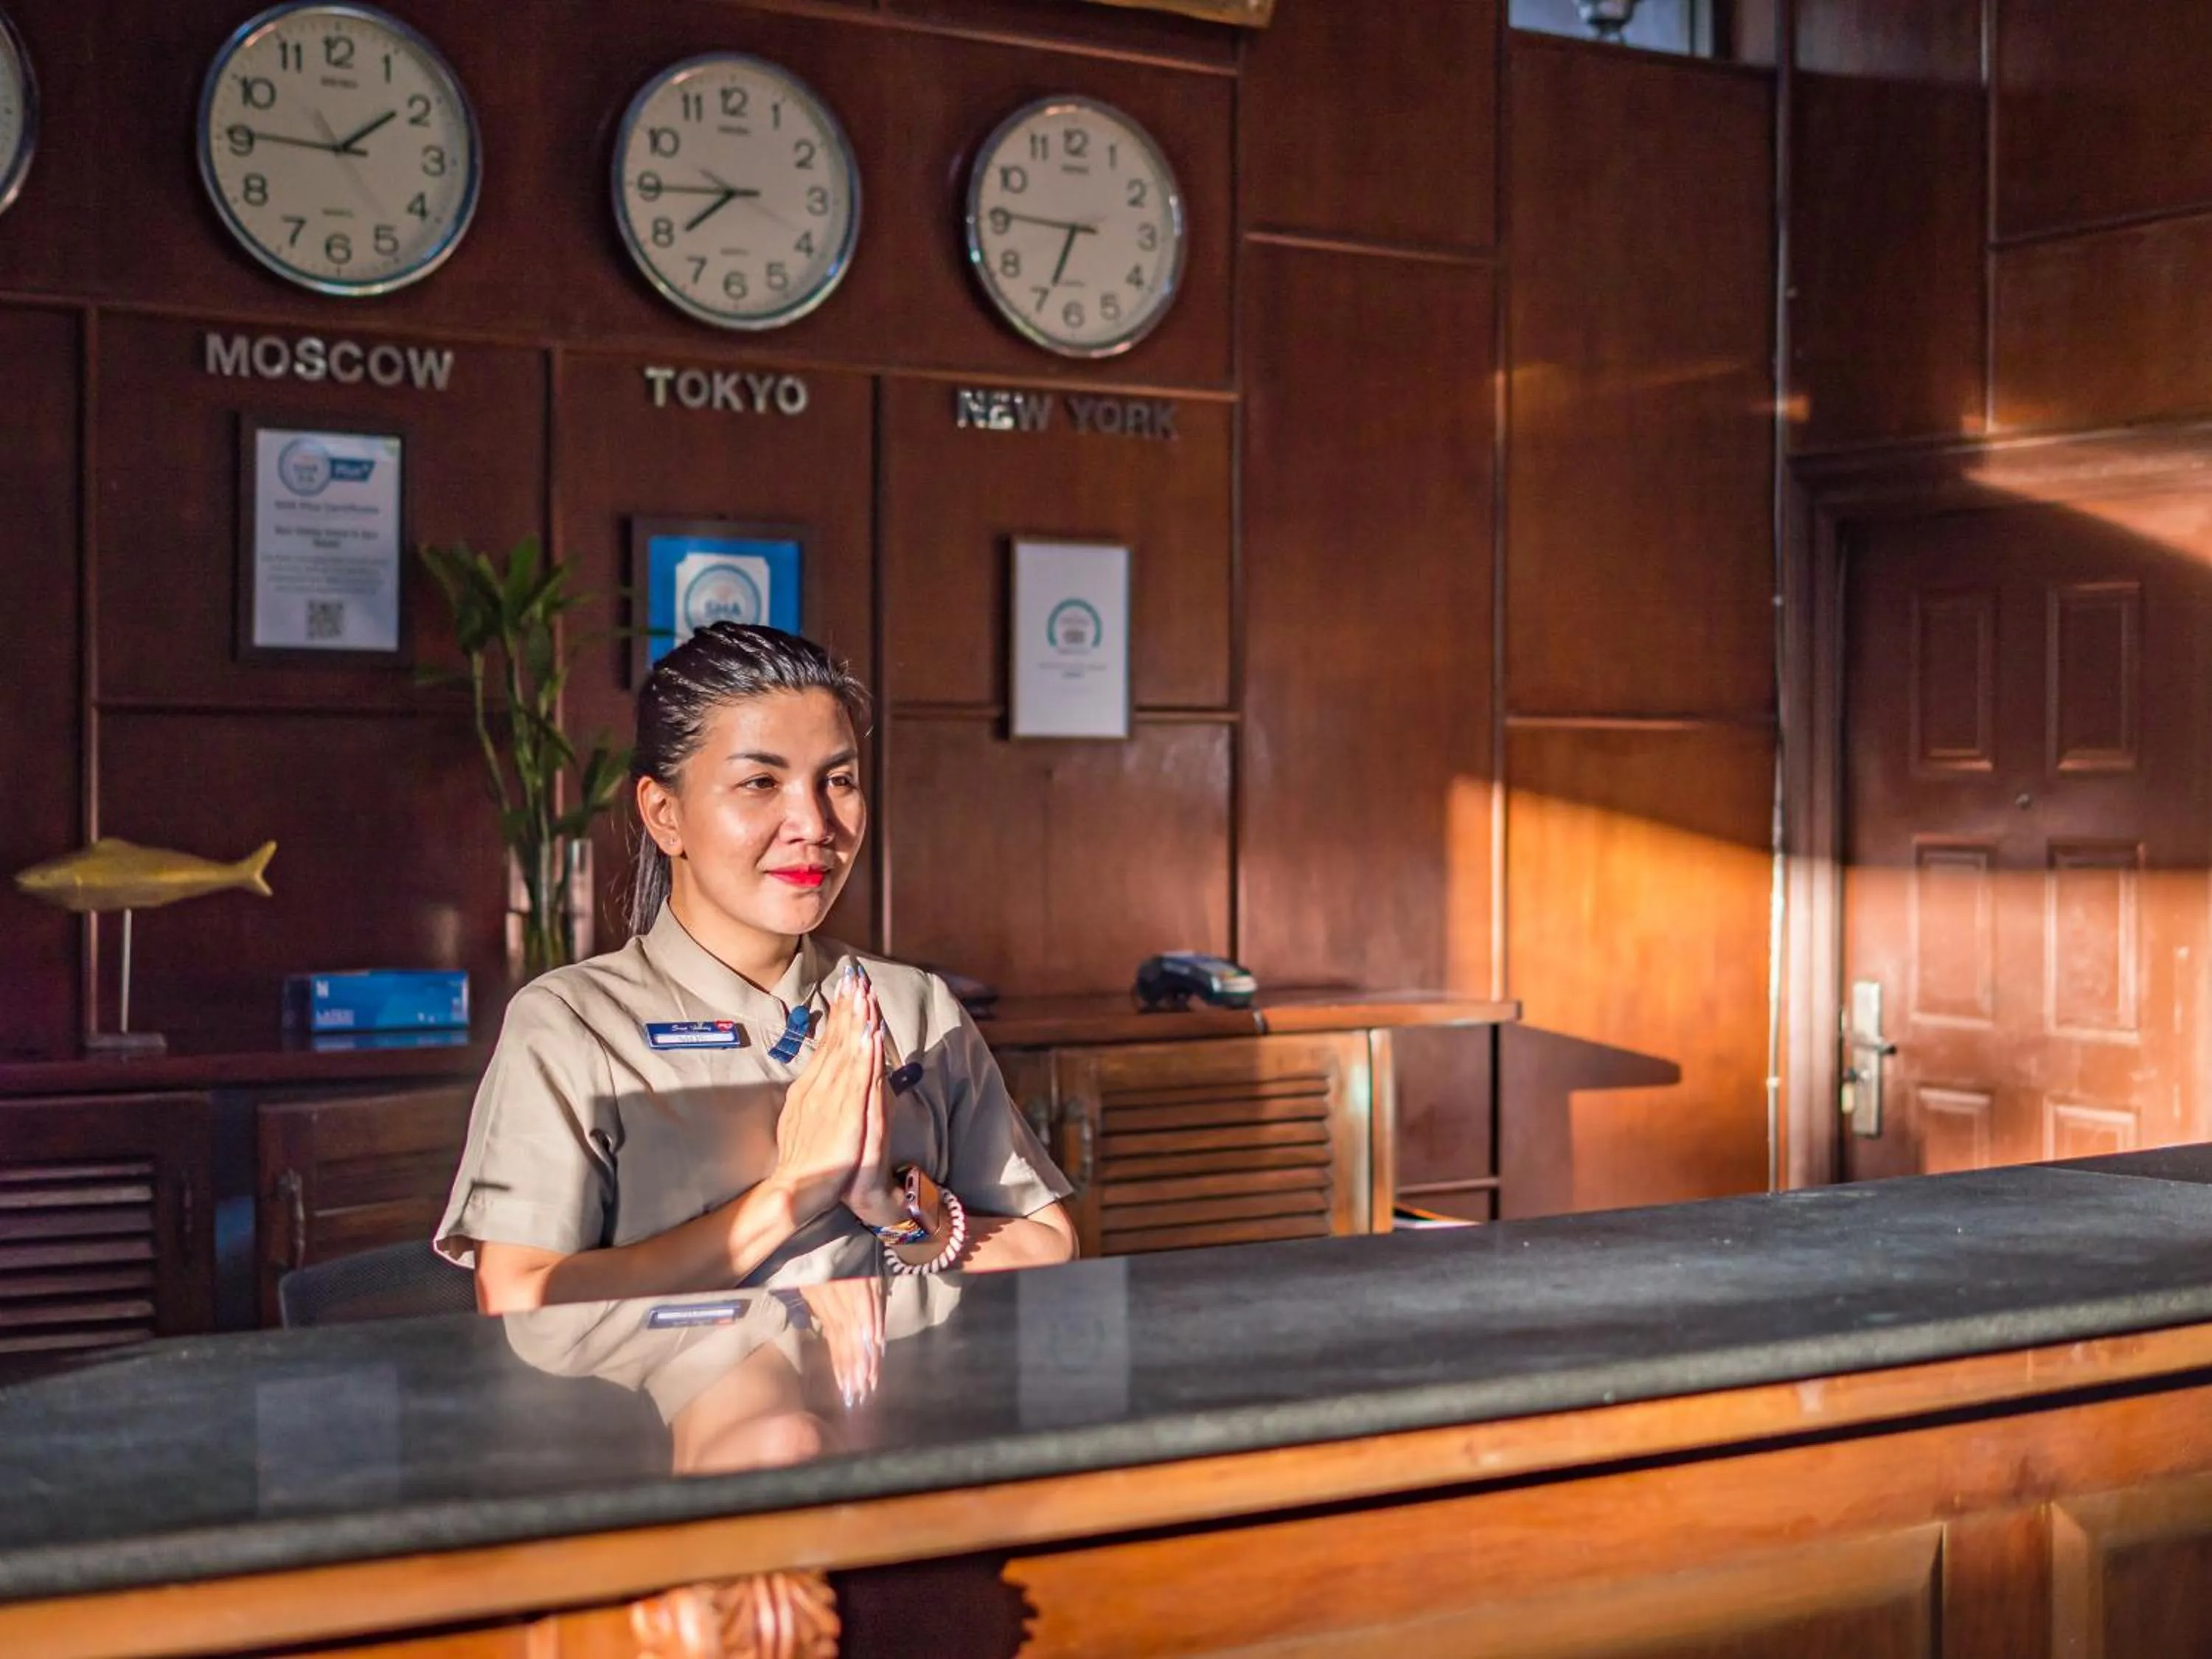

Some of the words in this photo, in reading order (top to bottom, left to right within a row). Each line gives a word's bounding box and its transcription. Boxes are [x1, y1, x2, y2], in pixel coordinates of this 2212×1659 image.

[279, 41, 302, 72] 11
[322, 35, 355, 69] 12
[381, 53, 392, 83] 1
[240, 76, 276, 110] 10
[681, 93, 702, 122] 11
[720, 86, 748, 118] 12
[407, 94, 431, 128] 2
[771, 103, 781, 131] 1
[226, 124, 254, 156] 9
[649, 128, 680, 159] 10
[793, 139, 815, 170] 2
[1029, 133, 1049, 161] 11
[1063, 128, 1089, 158] 12
[421, 145, 446, 177] 3
[1108, 143, 1117, 170] 1
[243, 173, 268, 207] 8
[637, 170, 663, 202] 9
[1000, 165, 1029, 195] 10
[1126, 178, 1147, 208] 2
[406, 192, 430, 221] 4
[806, 187, 828, 216] 3
[282, 216, 307, 247] 7
[652, 218, 674, 248] 8
[989, 206, 1012, 235] 9
[324, 233, 352, 265] 6
[373, 224, 400, 256] 5
[793, 231, 814, 258] 4
[1137, 223, 1157, 251] 3
[686, 255, 707, 285] 7
[765, 262, 789, 291] 5
[1000, 249, 1020, 279] 8
[1125, 264, 1144, 289] 4
[723, 271, 748, 300] 6
[1031, 285, 1050, 313] 7
[1062, 301, 1086, 330] 6
[1100, 293, 1121, 321] 5
[206, 333, 455, 392] MOSCOW
[644, 366, 808, 417] TOKYO
[957, 390, 1054, 432] NEW
[1069, 398, 1178, 441] YORK
